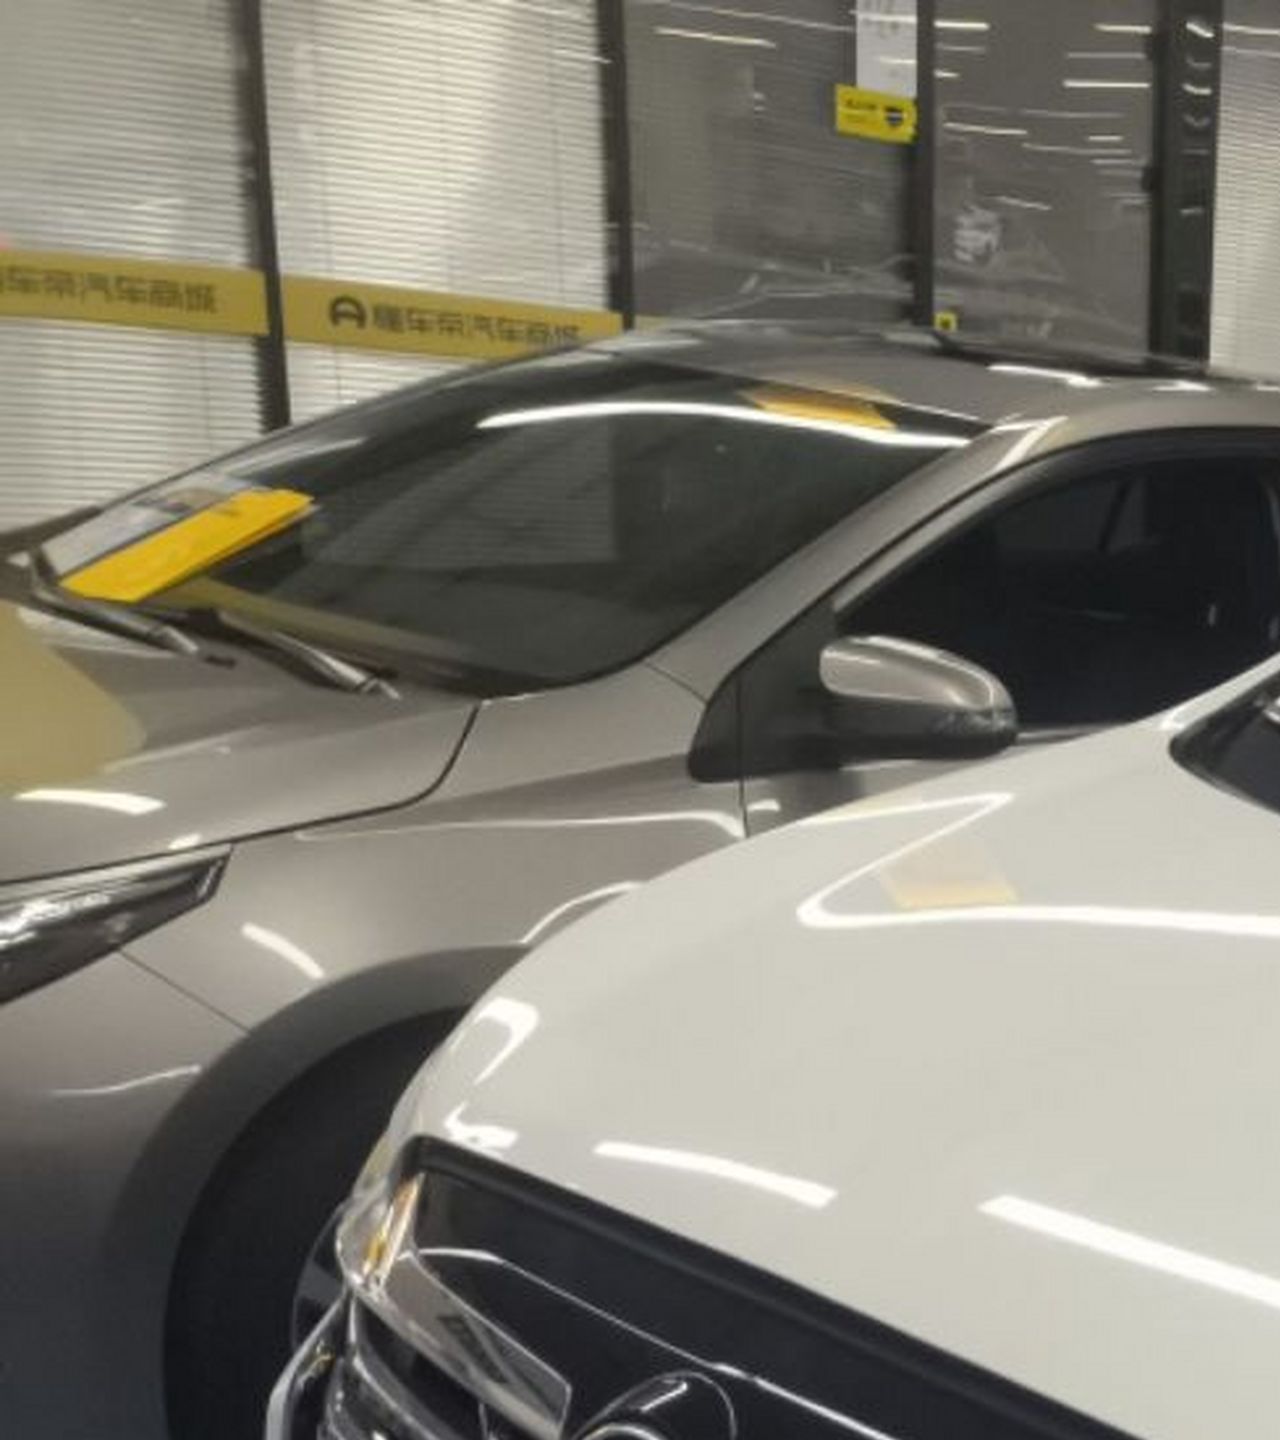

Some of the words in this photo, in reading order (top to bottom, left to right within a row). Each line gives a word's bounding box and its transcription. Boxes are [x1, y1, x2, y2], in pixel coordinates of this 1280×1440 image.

[0, 264, 219, 315] 车帝汽车商城
